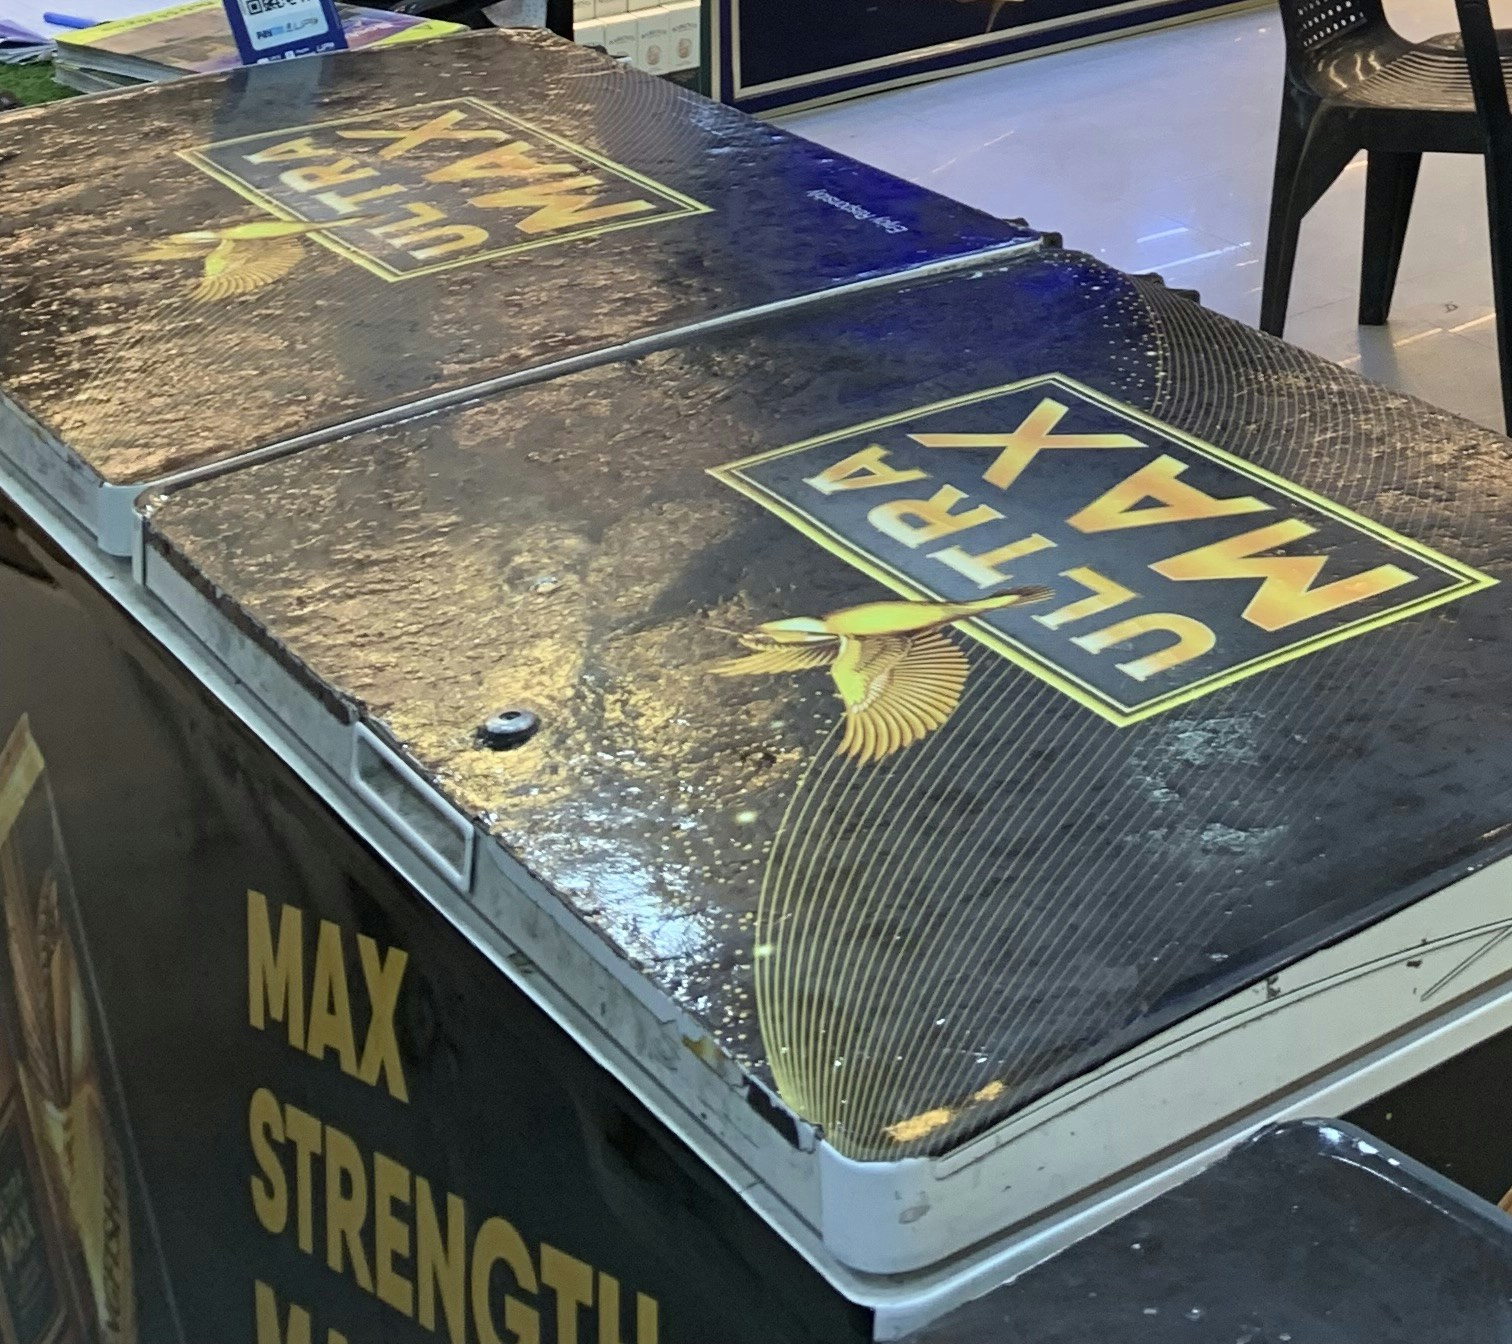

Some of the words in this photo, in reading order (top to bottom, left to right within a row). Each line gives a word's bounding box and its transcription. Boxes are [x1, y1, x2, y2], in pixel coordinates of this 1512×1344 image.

[244, 135, 491, 261] ULTRA
[334, 109, 663, 236] MAX
[801, 444, 1217, 684] ULTRA
[908, 395, 1418, 634] MAX
[246, 888, 410, 1104] MAX
